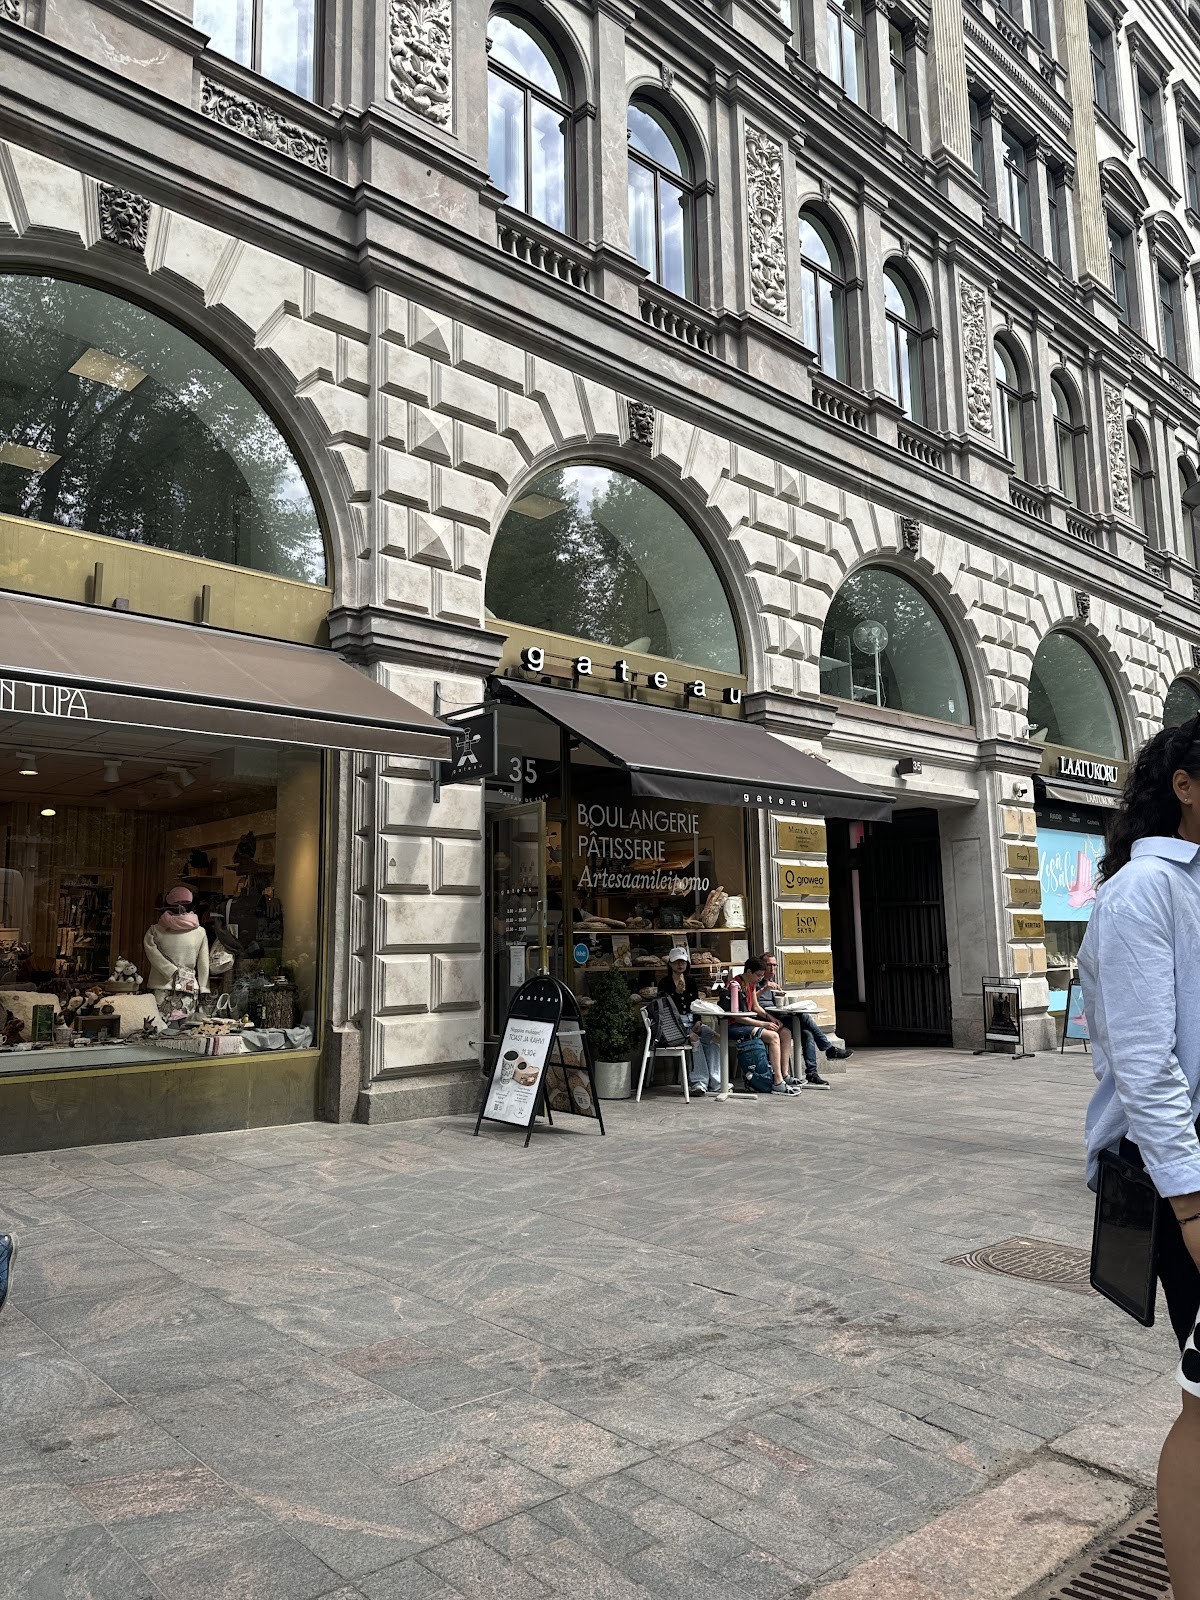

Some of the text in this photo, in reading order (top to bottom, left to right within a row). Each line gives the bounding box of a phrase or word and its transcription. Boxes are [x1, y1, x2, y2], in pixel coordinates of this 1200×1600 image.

[526, 646, 742, 704] gateau
[25, 682, 88, 719] TUPA
[509, 757, 537, 784] 35
[912, 761, 922, 771] 35
[1060, 756, 1119, 783] LAATUKORU
[743, 793, 808, 808] gateau
[577, 803, 700, 835] BOULANGERIE
[577, 830, 666, 861] PÂTISSERIE
[577, 864, 710, 896] Artesaanileipomo
[1024, 921, 1041, 929] VERITAS
[519, 995, 559, 1003] gateau
[508, 1033, 523, 1042] TOAST
